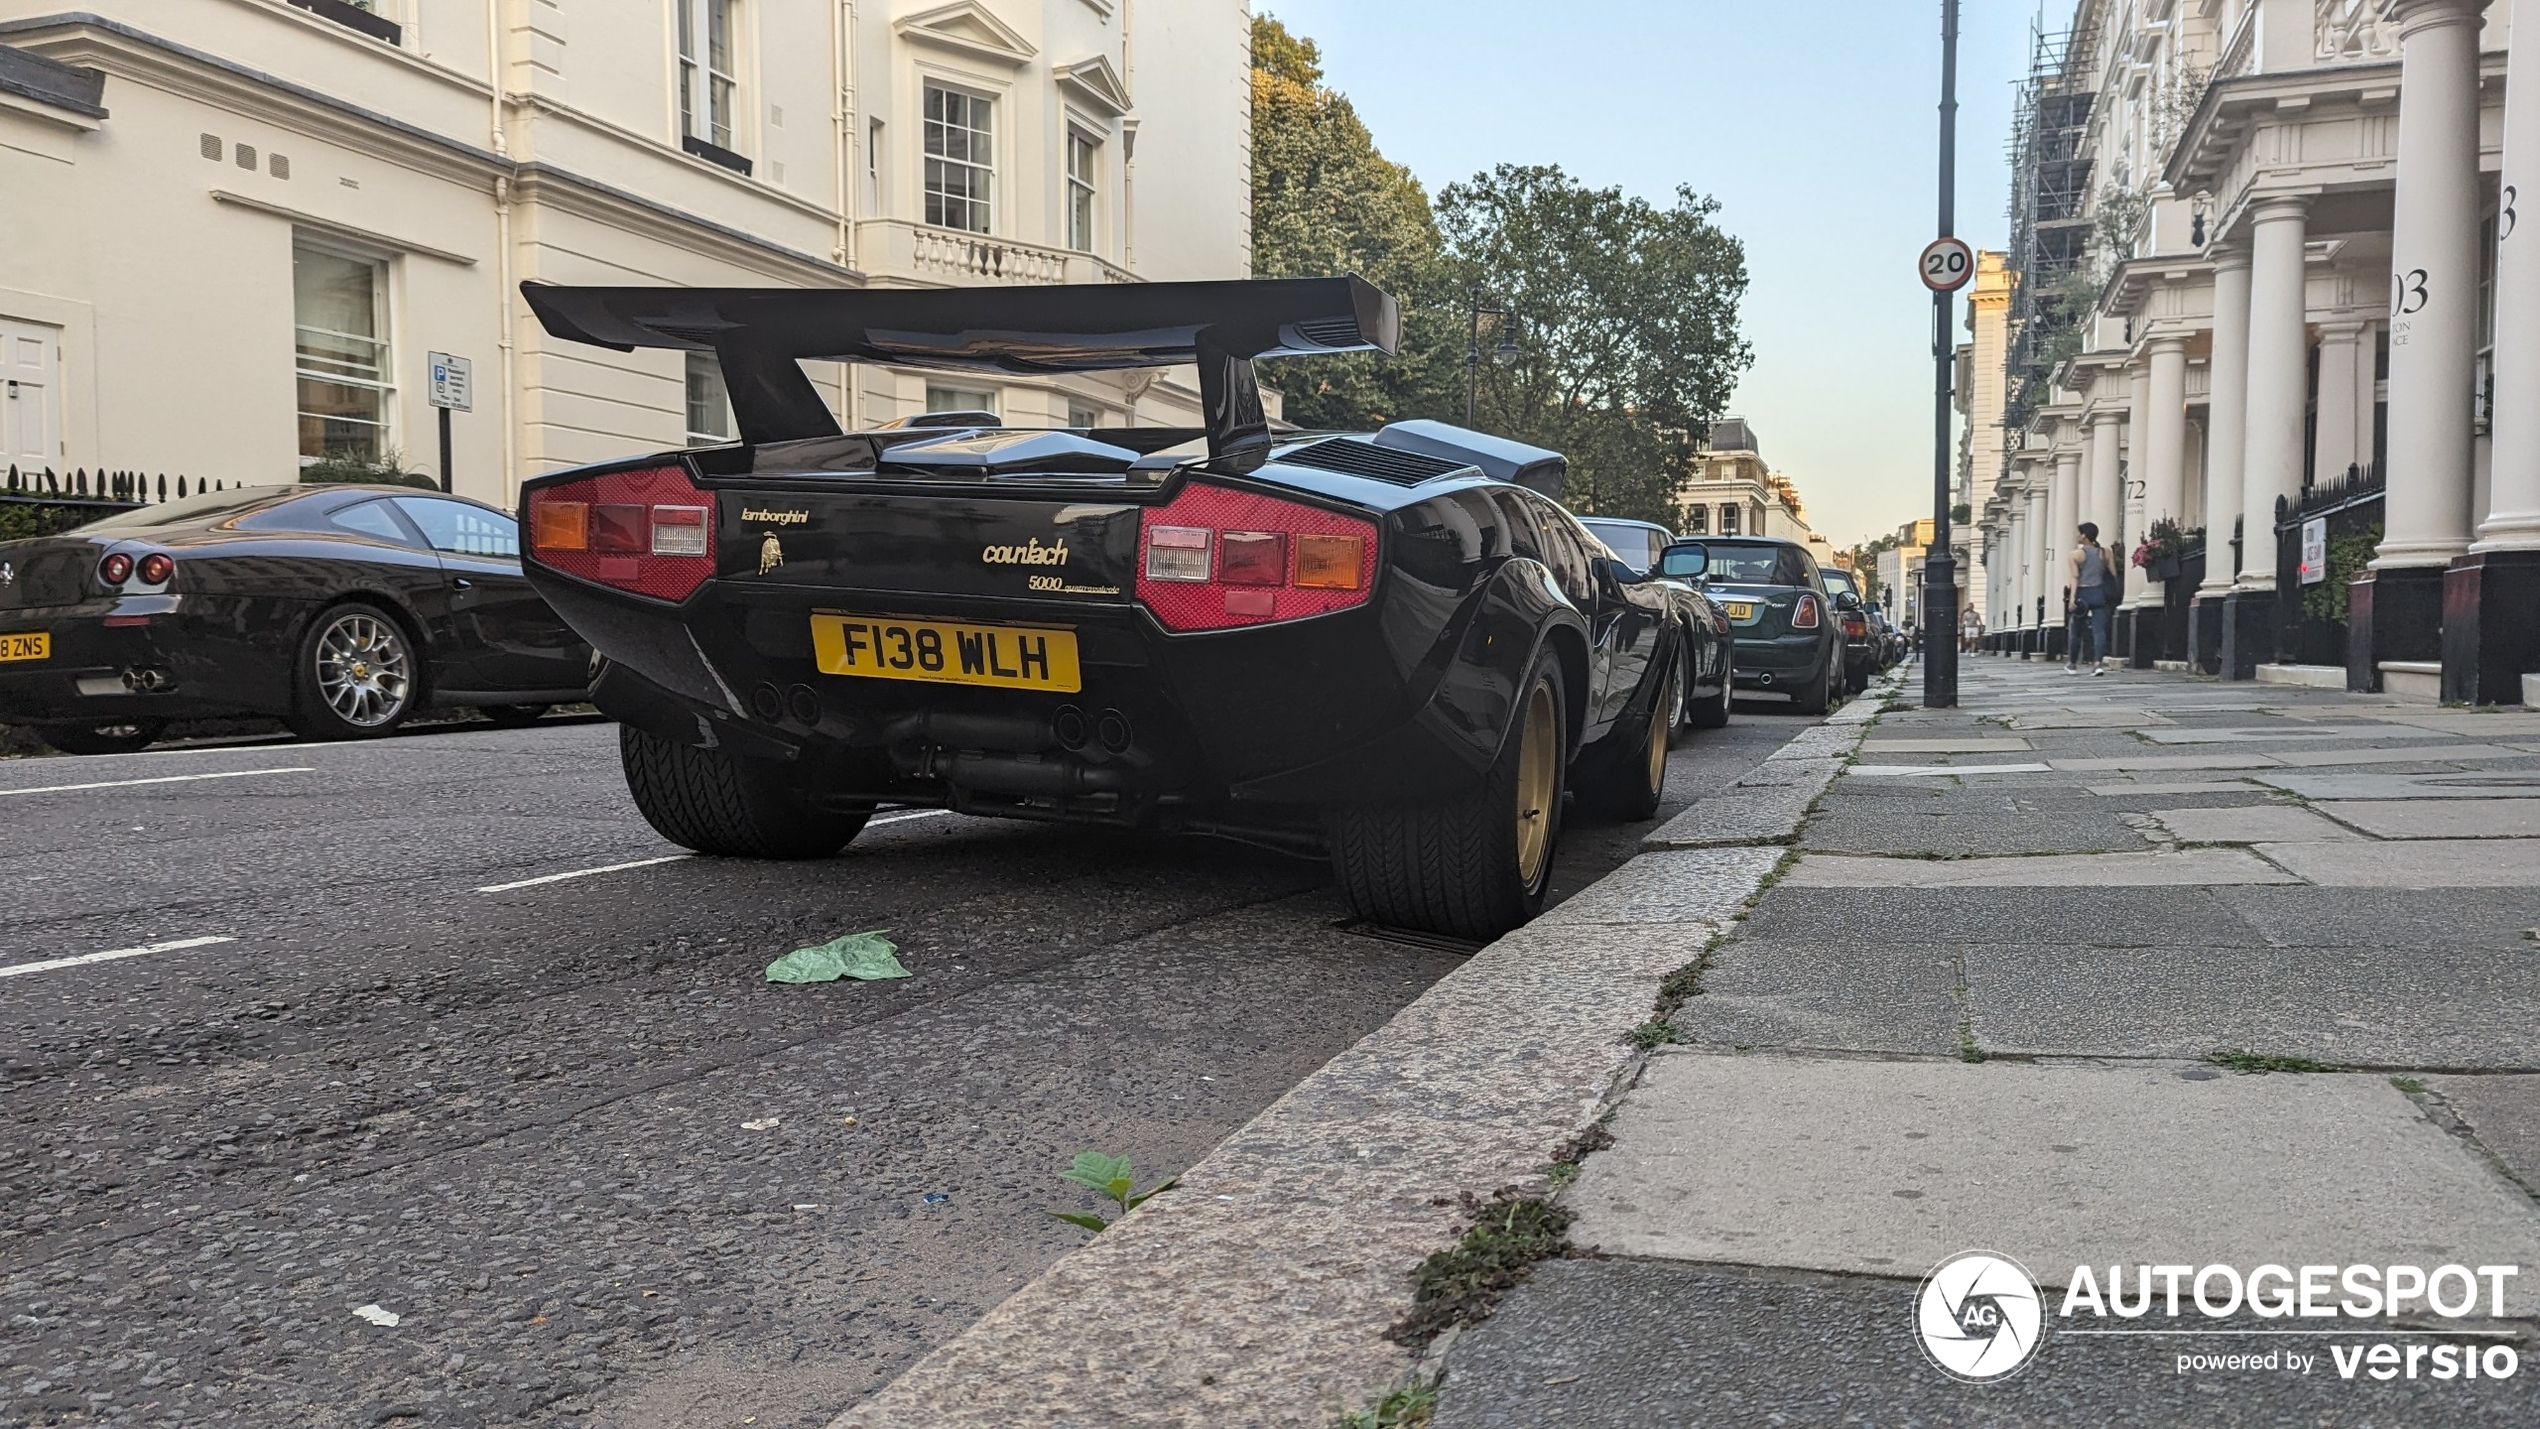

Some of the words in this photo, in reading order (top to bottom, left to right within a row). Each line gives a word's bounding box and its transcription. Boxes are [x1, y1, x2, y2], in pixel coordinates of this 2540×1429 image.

[1927, 252, 1965, 275] 20
[2127, 480, 2147, 500] 72
[741, 507, 809, 526] lamborghini
[982, 537, 1069, 566] countach
[1028, 575, 1063, 590] 5000
[1727, 603, 1747, 616] JD
[13, 636, 43, 657] ZNS
[841, 622, 945, 672] F138
[955, 630, 1050, 681] WLH
